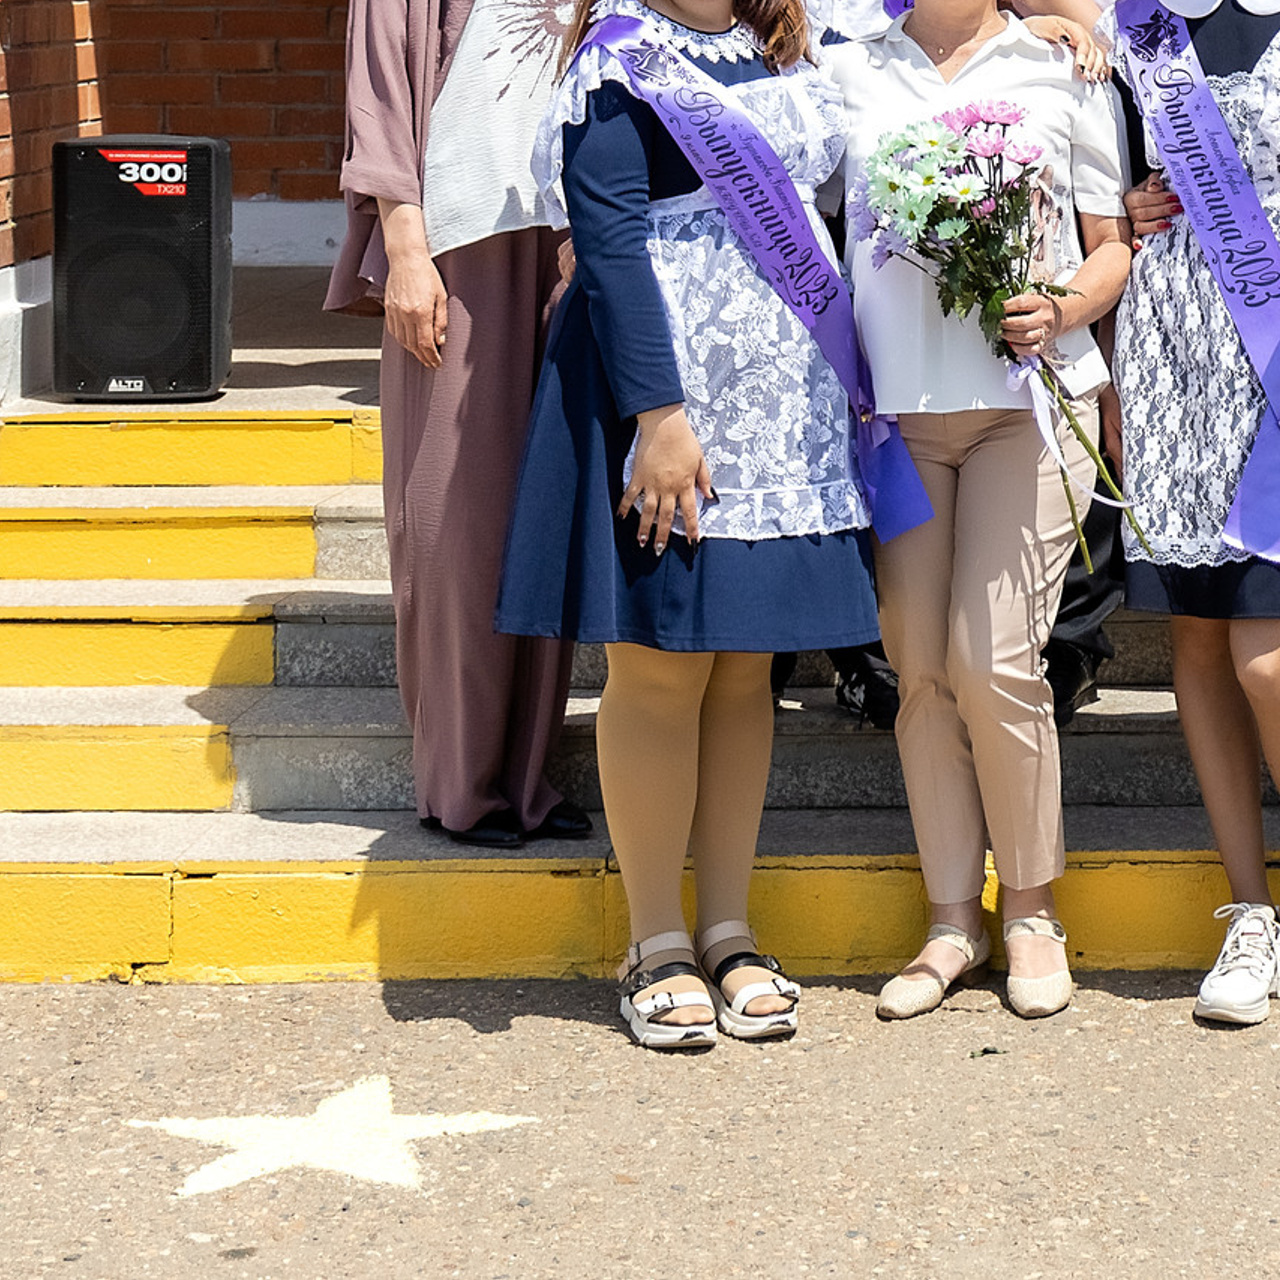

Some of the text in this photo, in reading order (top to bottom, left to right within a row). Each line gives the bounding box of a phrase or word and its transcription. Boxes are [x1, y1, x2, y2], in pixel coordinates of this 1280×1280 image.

[1153, 64, 1243, 245] Выпускница
[119, 162, 182, 183] 300
[157, 184, 185, 194] TX210
[672, 86, 838, 316] Выпускница 2023
[109, 378, 143, 391] ALTO
